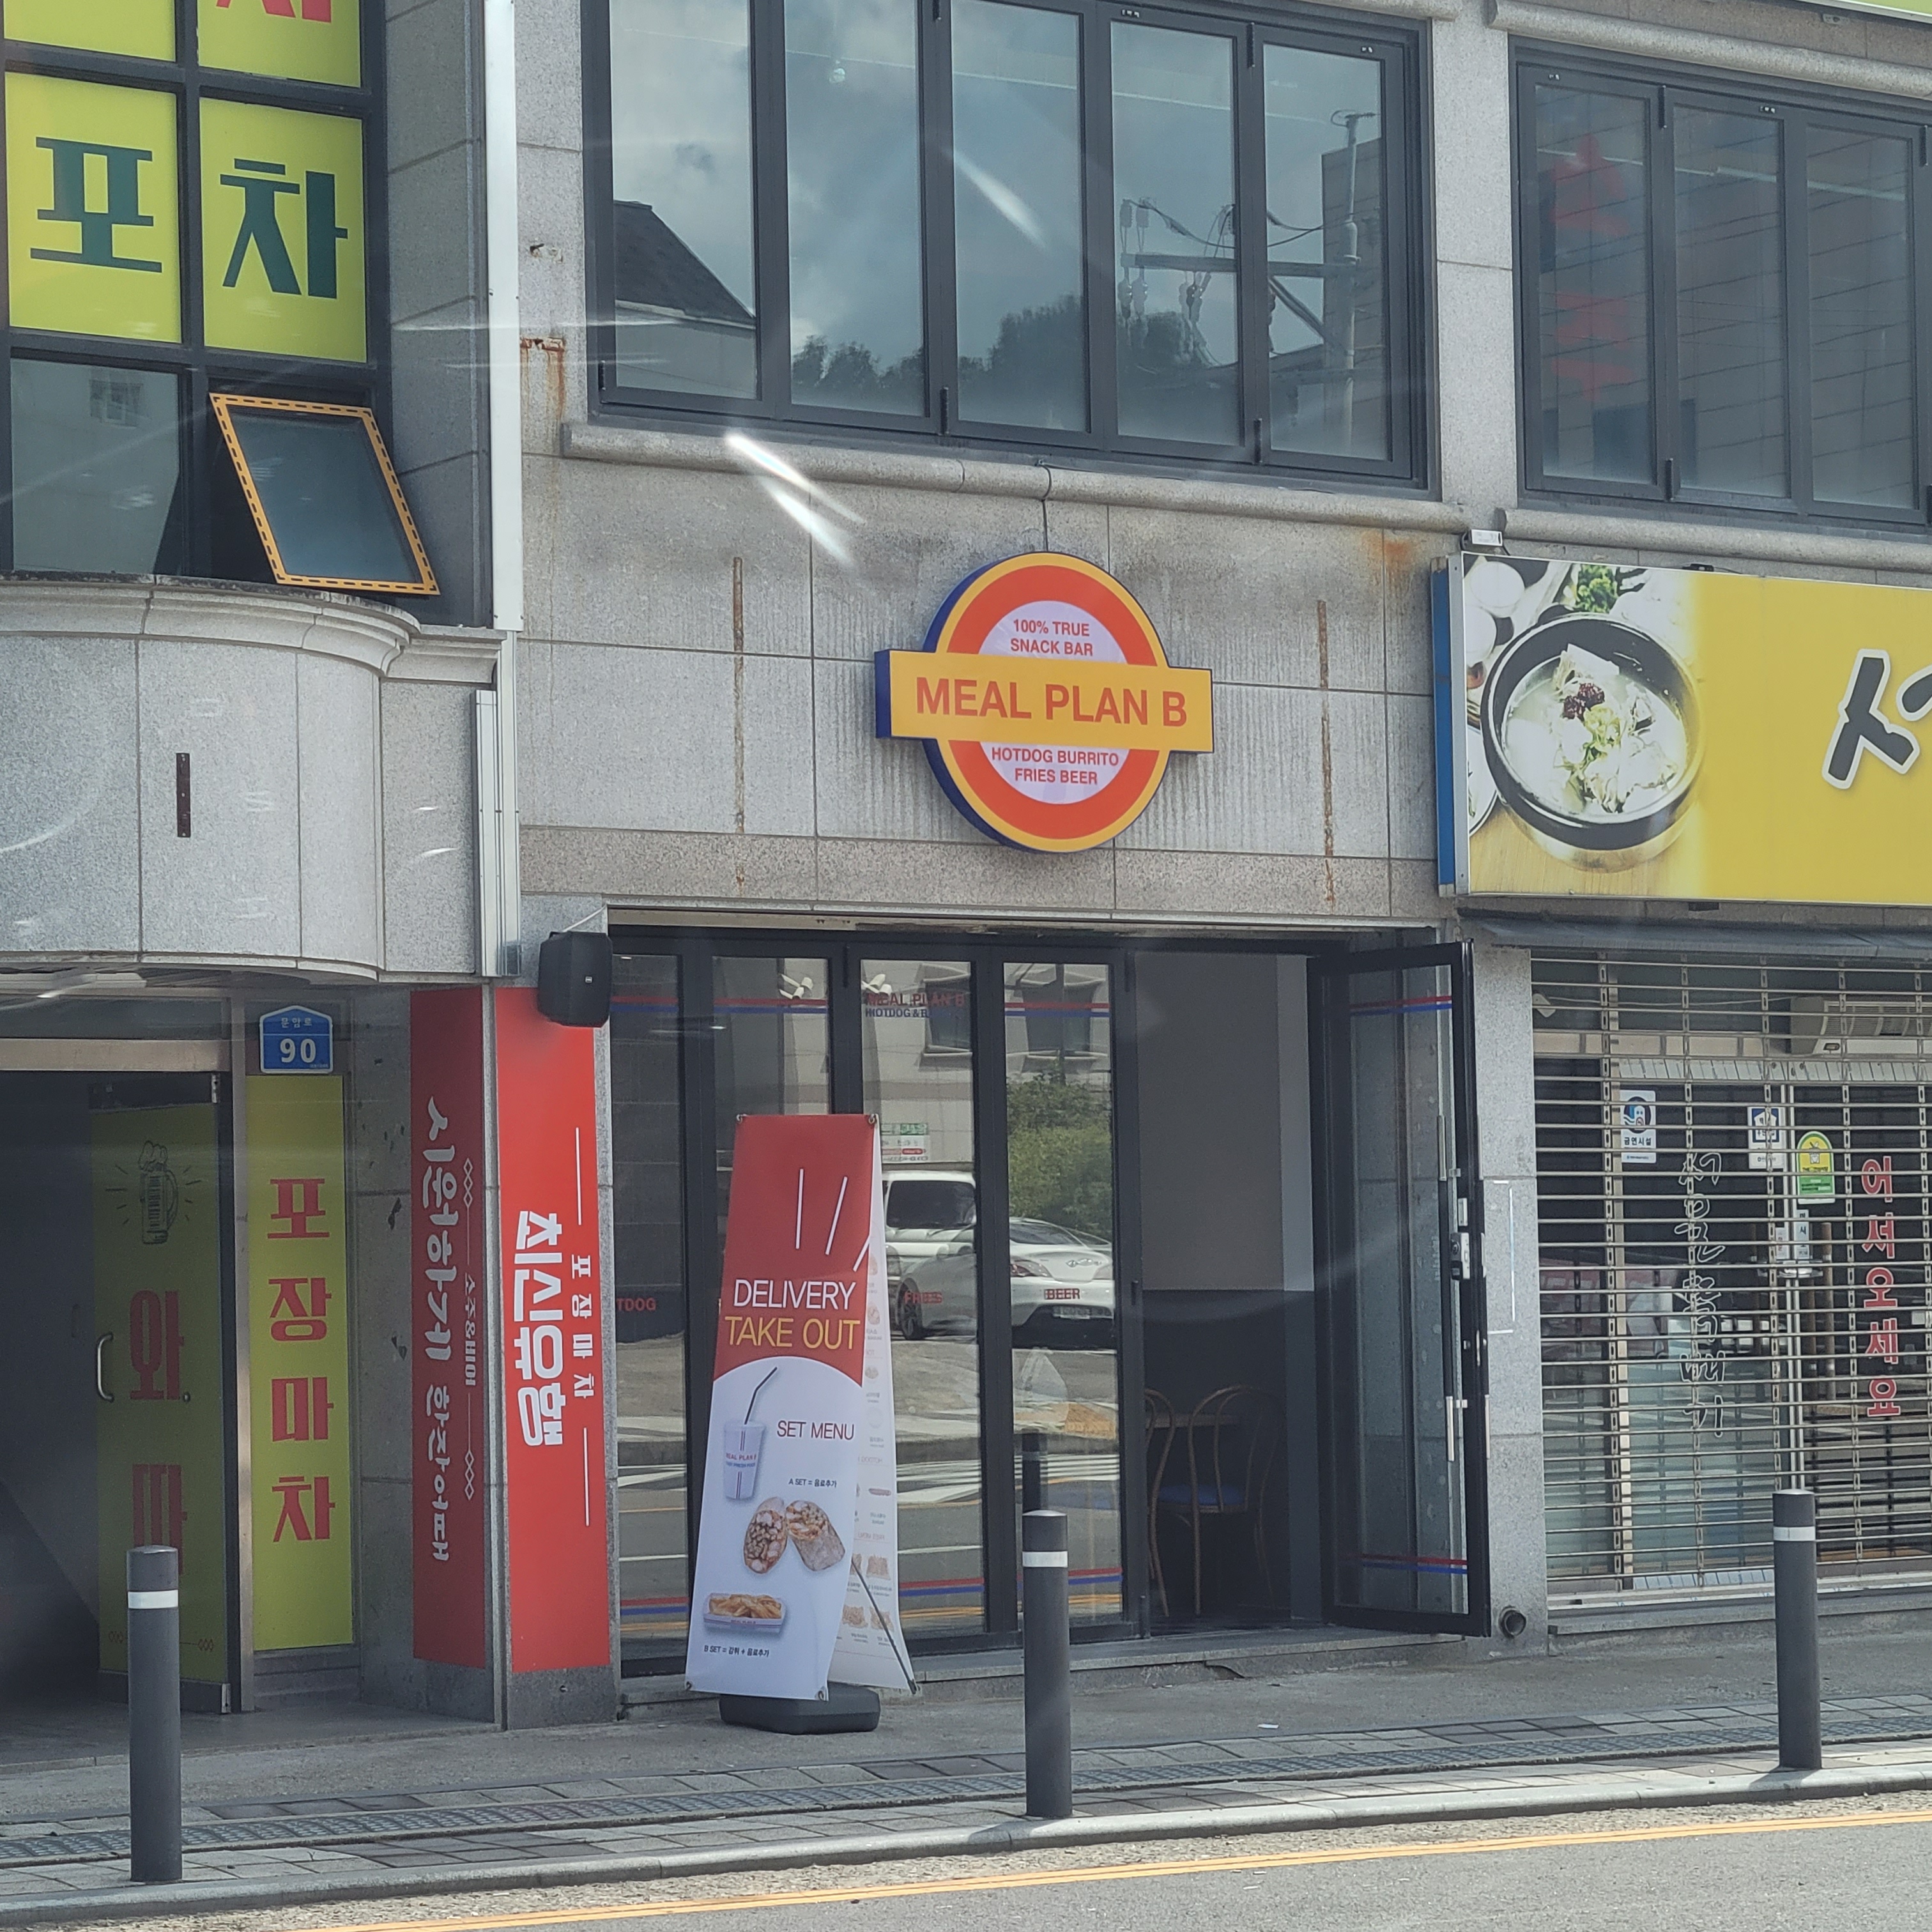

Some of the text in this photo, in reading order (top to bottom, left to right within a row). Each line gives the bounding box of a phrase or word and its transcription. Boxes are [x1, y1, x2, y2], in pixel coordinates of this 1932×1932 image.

[30, 136, 348, 300] 포차
[1013, 618, 1090, 636] 100% TRUE
[1010, 638, 1093, 656] SNACK BAR
[916, 676, 1188, 727] MEAL PLAN B
[991, 746, 1119, 767] HOTDOG BURRITO
[1014, 768, 1098, 785] FRIES BEER
[281, 1017, 312, 1028] 문암로
[280, 1038, 316, 1063] 90
[1623, 1137, 1652, 1146] 금연시설
[422, 1096, 459, 1361] 시원하게
[733, 1278, 856, 1310] DELIVERY
[1046, 1288, 1080, 1300] BEER
[1860, 1155, 1901, 1417] 어서오세요
[616, 1298, 656, 1312] TDOG
[464, 1273, 477, 1386] 소주&비어
[514, 1210, 566, 1446] 최신유행
[572, 1254, 595, 1399] 포장마차
[724, 1315, 861, 1350] TAKE OUT
[267, 1178, 335, 1543] 포장마차
[776, 1420, 855, 1441] SET MENU
[426, 1384, 451, 1561] 한잔어때
[813, 1478, 838, 1488] 음료추가
